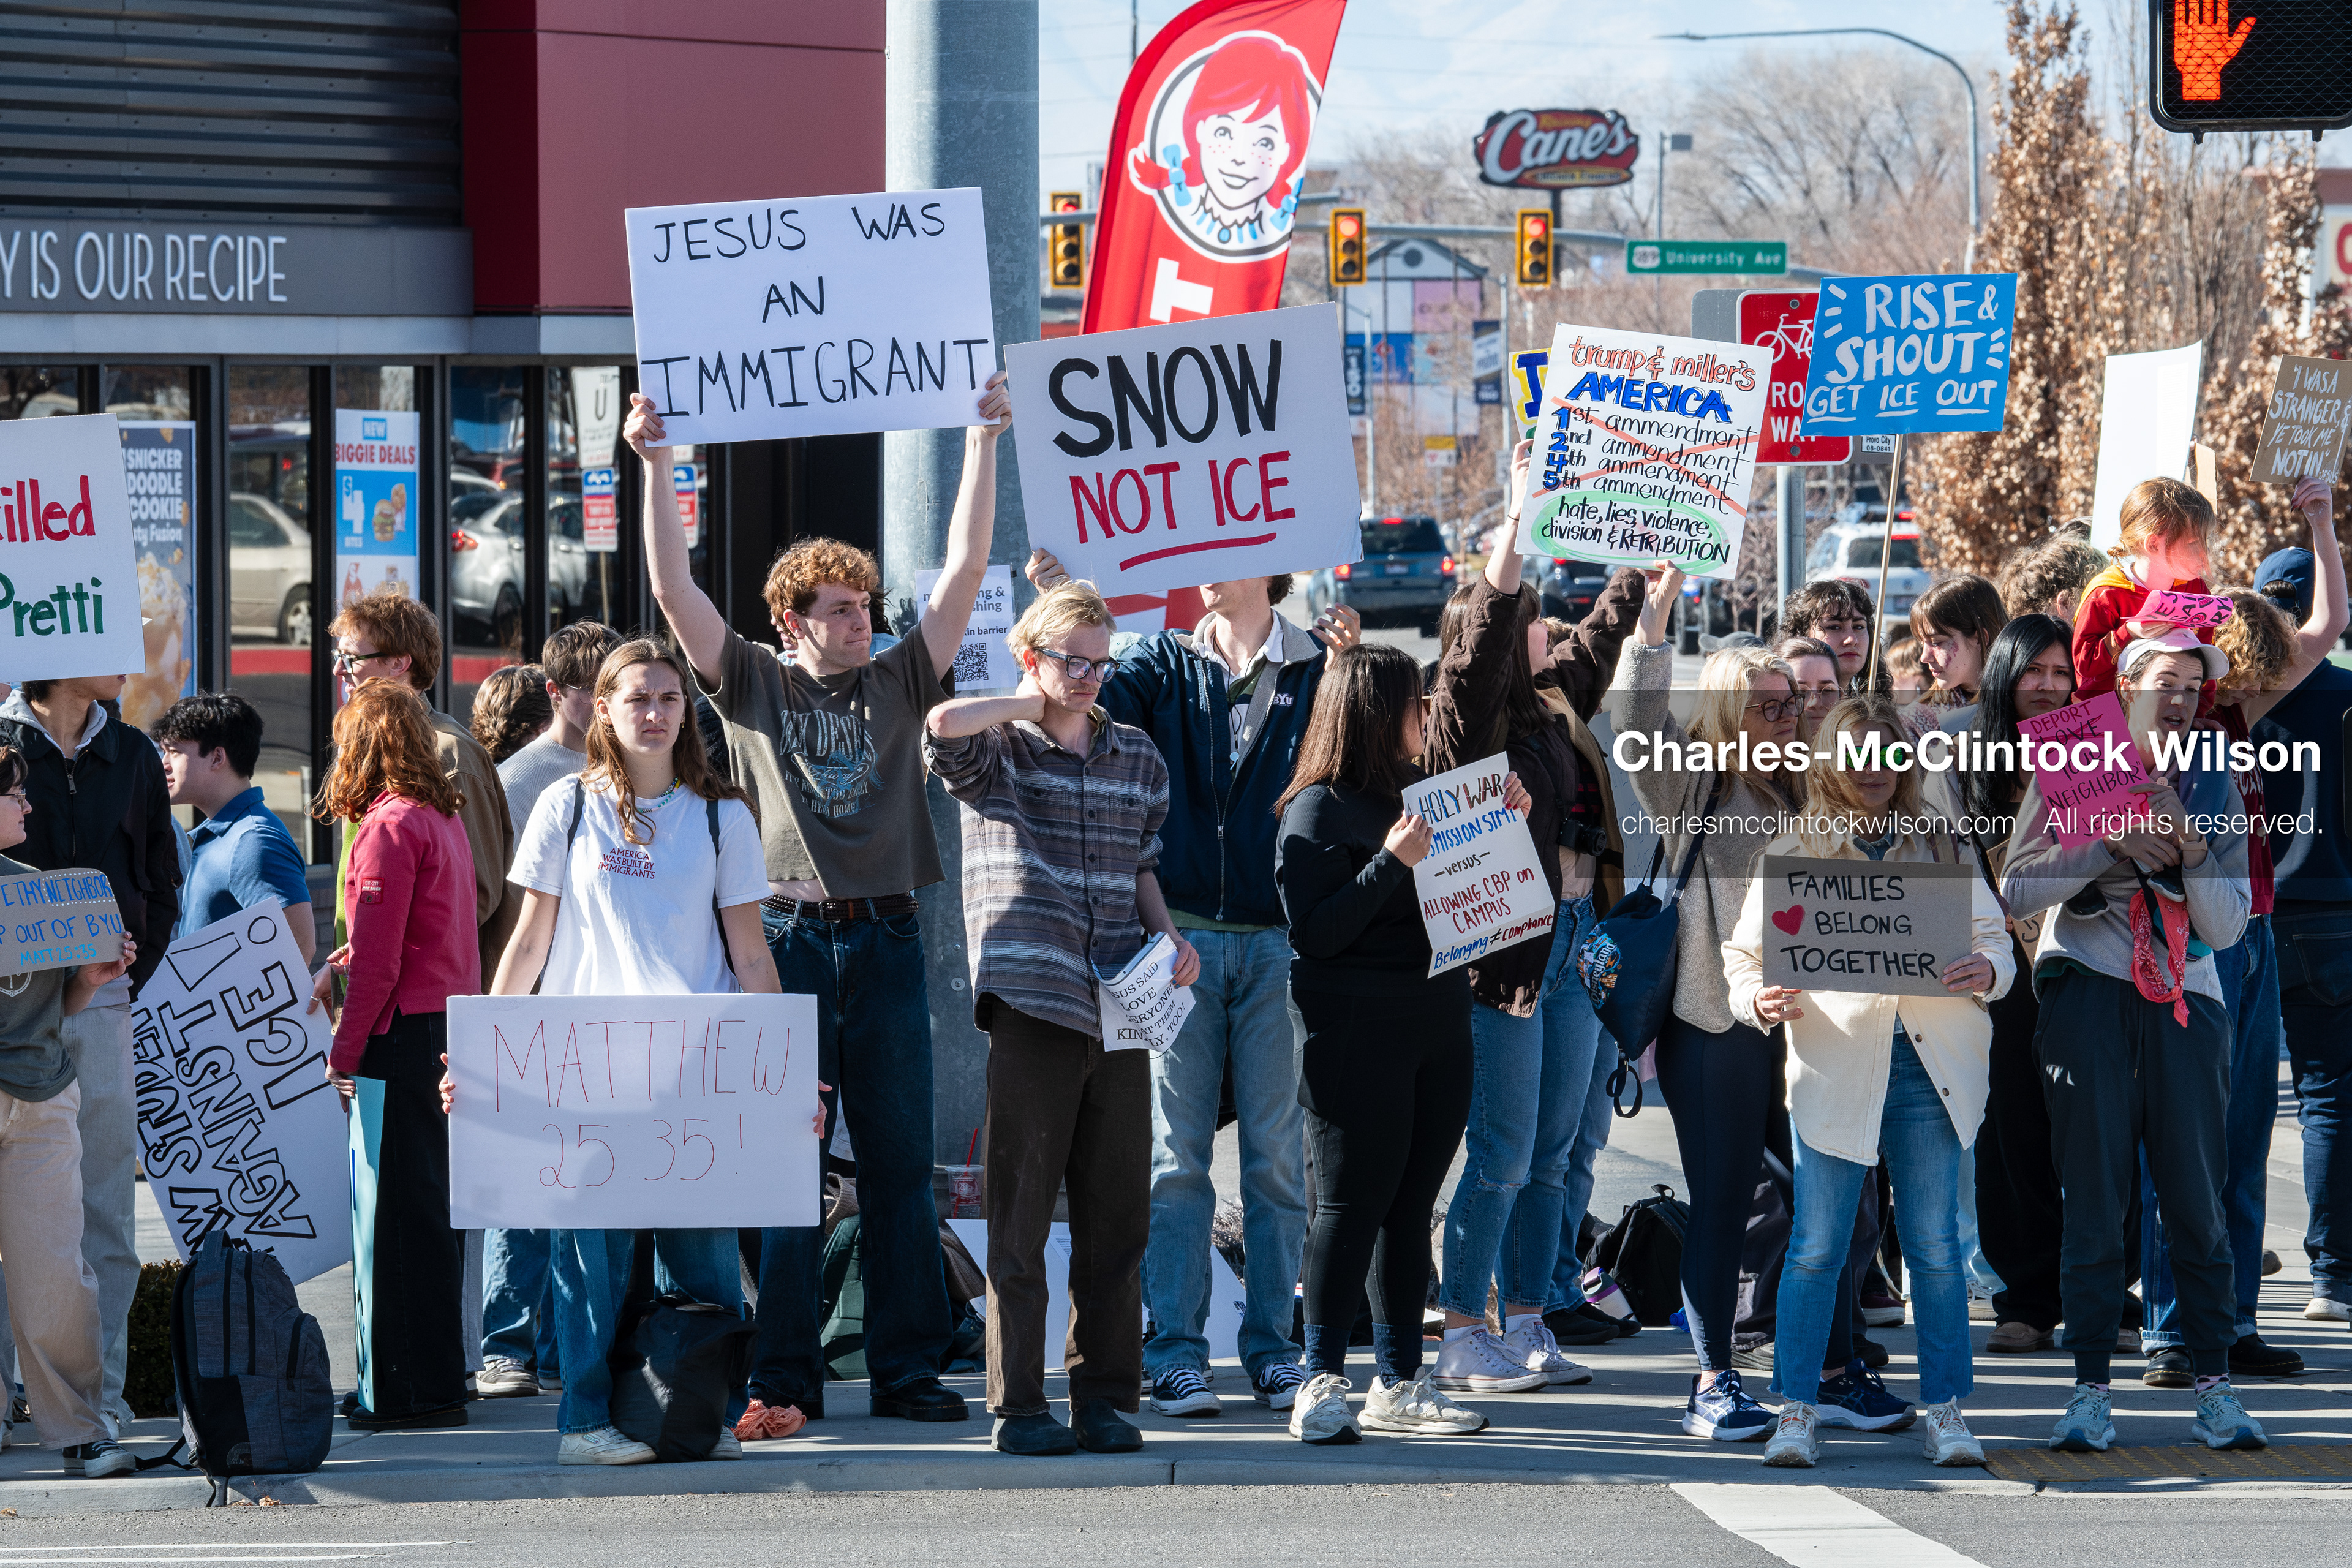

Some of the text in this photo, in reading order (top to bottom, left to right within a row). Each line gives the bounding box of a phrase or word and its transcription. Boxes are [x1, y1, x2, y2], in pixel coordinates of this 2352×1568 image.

[1483, 110, 1636, 184] Cane's
[654, 203, 944, 262] JESUS WAS
[31, 232, 61, 300] IS
[74, 232, 153, 301] OUR
[165, 233, 287, 302] RECIPE
[1665, 249, 1744, 269] University
[1754, 251, 1781, 266] Ave
[762, 276, 824, 323] AN
[1863, 282, 1999, 334] RISE &
[1569, 336, 1756, 391] trump & miller's
[1825, 331, 1987, 384] SHOUT
[641, 337, 989, 417] IMMIGRANT
[1772, 381, 1804, 408] RO
[2304, 367, 2330, 394] WAS
[2326, 369, 2339, 394] A
[1049, 339, 1282, 458] SNOW
[1565, 372, 1733, 424] AMERICA
[1806, 380, 1998, 418] GET ICE OUT
[2269, 390, 2342, 428] STRANGER,
[364, 422, 385, 437] NEW
[1551, 406, 1757, 454] 1st ammendment
[1770, 417, 1815, 442] WA
[1866, 435, 1891, 445] Provo City
[2267, 422, 2336, 449] YE TOOK ME
[126, 447, 183, 470] SNICKER
[336, 443, 416, 465] BIGGIE DEALS
[1548, 429, 1751, 480] 2nd ammendment
[2271, 447, 2309, 478] NOT
[127, 471, 183, 496] DOODLE
[1545, 449, 1586, 473] 4th
[1598, 456, 1738, 499] ammendment
[129, 496, 183, 521] COOKIE
[1069, 450, 1296, 543] NOT ICE
[1542, 470, 1733, 515] 5th ammendment
[149, 522, 182, 542] Fusion
[1558, 495, 1604, 524] hate,
[1642, 509, 1713, 538] violence,
[1542, 517, 1602, 543] division
[1621, 529, 1731, 564] RETRIBUTION
[995, 586, 1005, 597] &
[978, 626, 1008, 635] barrier
[1273, 693, 1294, 706] BYU
[2030, 701, 2092, 735] DEPORT
[1419, 785, 1461, 825] HOLY
[1462, 774, 1504, 810] WAR
[1433, 817, 1482, 854] MISSION
[598, 861, 655, 880] IMMIGRANTS
[603, 854, 655, 870] WAS BUILT BY
[609, 847, 650, 861] AMERICA
[12, 878, 47, 907] THY
[45, 874, 113, 903] NEIGHBOR
[1424, 867, 1535, 921] ALLOWING CBP on
[1788, 870, 1906, 902] FAMILIES
[15, 919, 47, 943] OUT
[51, 916, 76, 939] OF
[85, 913, 123, 937] BYU
[1453, 897, 1512, 934] CAMPUS
[1815, 910, 1912, 937] BELONG
[20, 943, 97, 966] MATT 25:35
[1434, 935, 1488, 970] Belonging
[1502, 913, 1554, 943] compliance
[1136, 962, 1159, 987] SAID
[1591, 943, 1618, 1003] Disneyland
[1781, 944, 1939, 981] TOGETHER
[1120, 987, 1157, 1011] LOVE
[1128, 984, 1173, 1023] ERYONE
[1154, 999, 1176, 1029] THEM
[1167, 1002, 1186, 1034] TOO!
[494, 1017, 790, 1113] MATTHEW
[158, 999, 317, 1238] AGAINST
